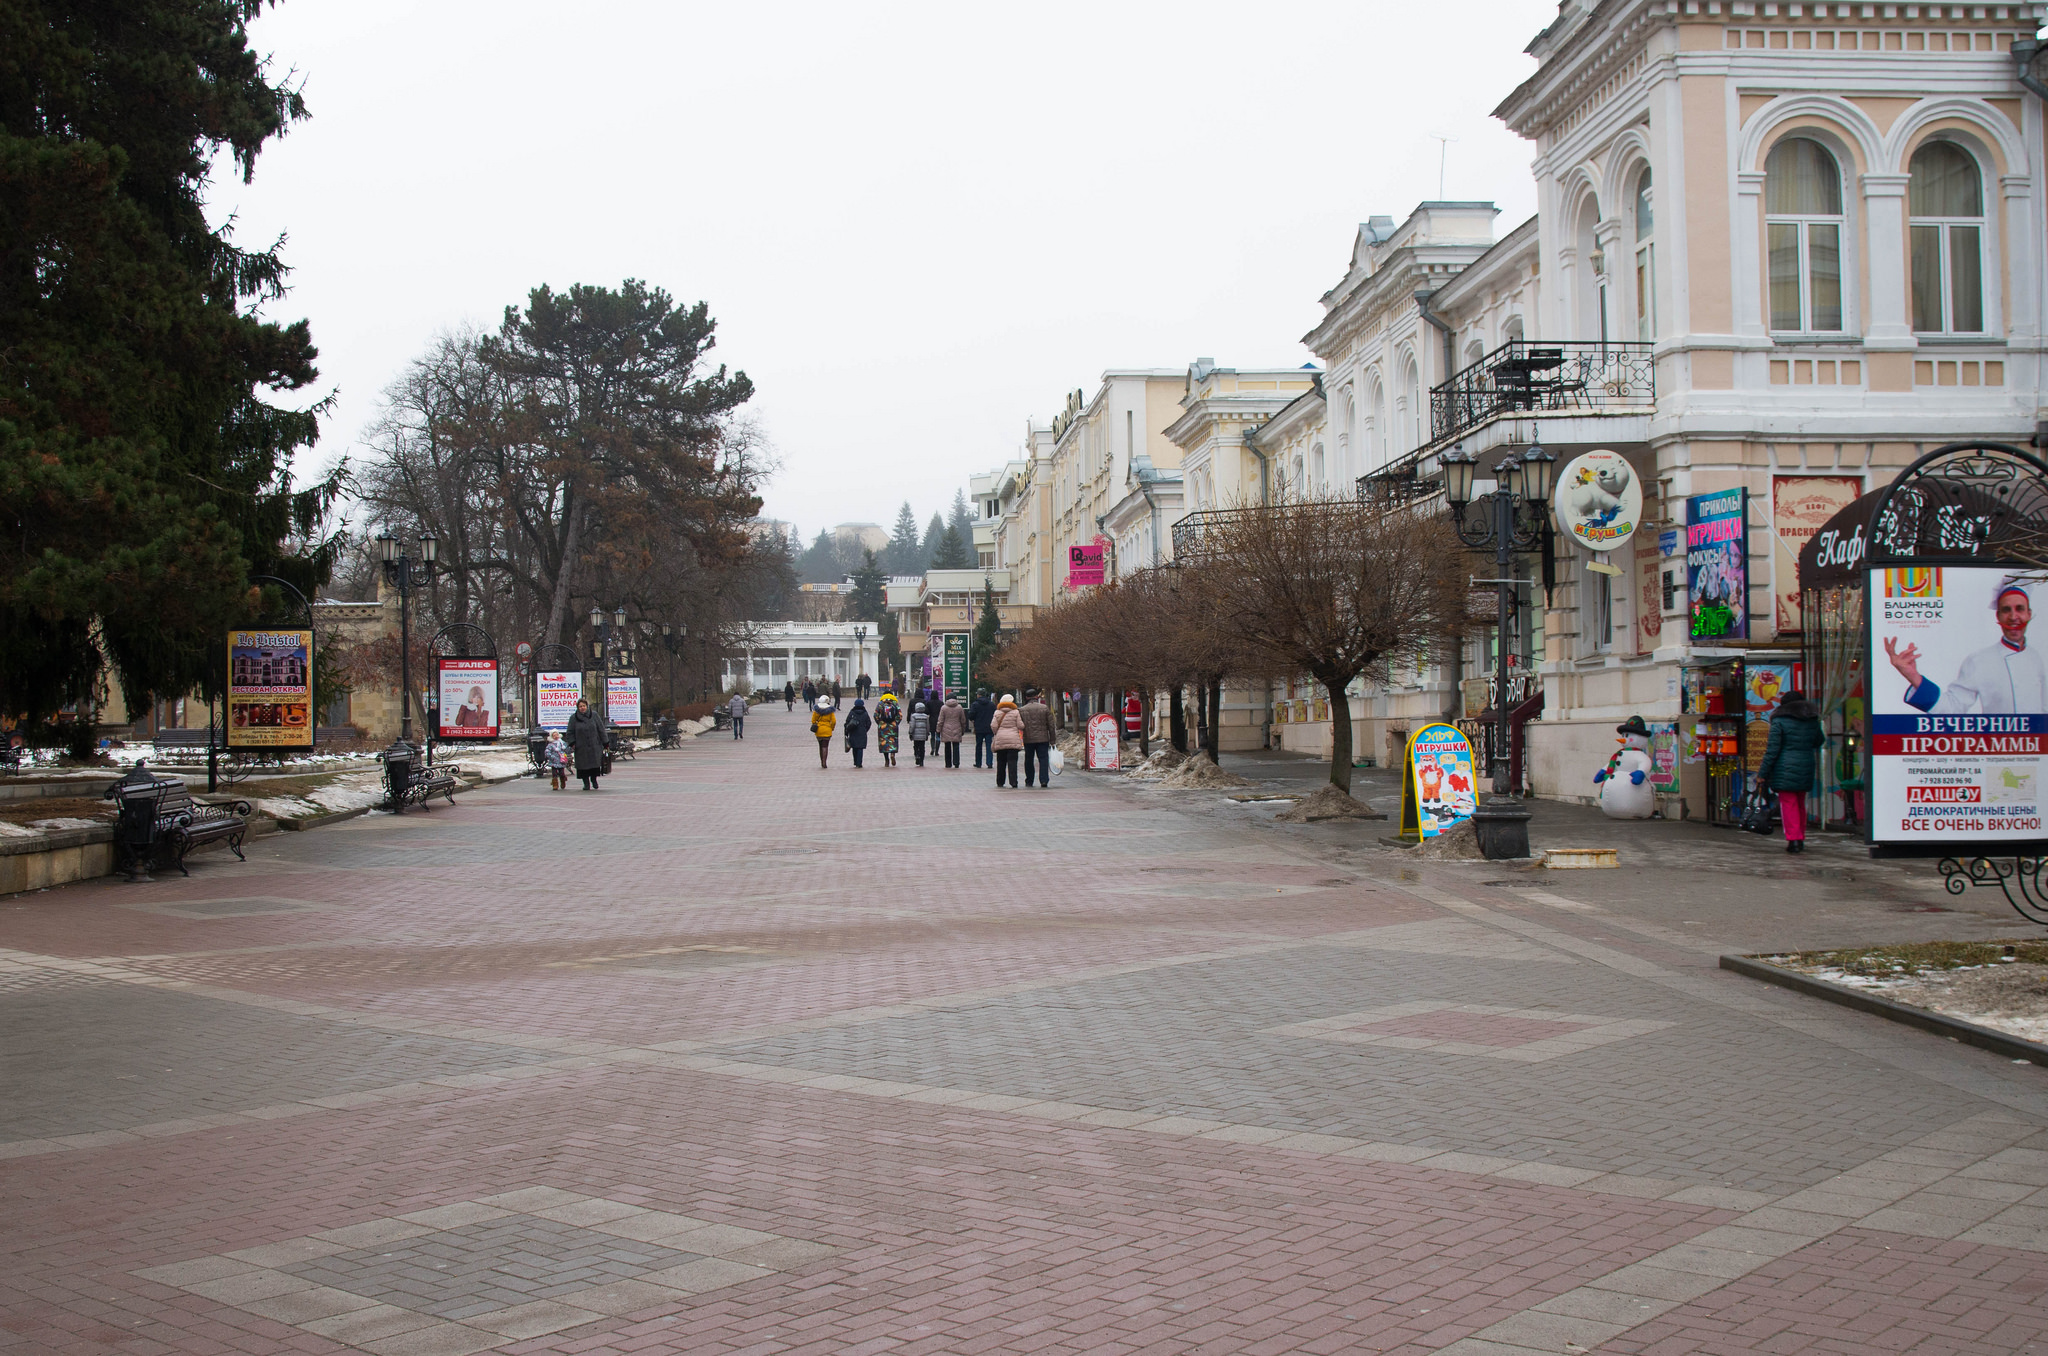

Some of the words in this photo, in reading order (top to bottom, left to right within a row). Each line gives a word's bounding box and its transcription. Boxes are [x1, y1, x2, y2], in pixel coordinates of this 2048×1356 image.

[1700, 494, 1741, 518] ПРИКОЛЫ
[1575, 521, 1633, 542] игрушки
[1688, 517, 1742, 547] ИГРУШКИ
[1071, 548, 1102, 562] David
[1688, 547, 1723, 568] ФОКУСЫ
[1884, 599, 1944, 609] БЛИЖНИЙ
[237, 633, 254, 647] Le
[255, 632, 301, 648] Bristol
[231, 685, 270, 694] РЕСТОРАН
[271, 685, 306, 694] ОТКРЫТ
[540, 692, 579, 700] ШУБНАЯ
[1490, 676, 1526, 704] БЬВАР
[1916, 716, 2031, 733] ВЕЧЕРНИЕ
[1425, 731, 1456, 742] ЭЛЬФ
[1415, 741, 1468, 753] ИГРУШКИ
[1901, 737, 2041, 753] ПРОГРАММЫ
[1908, 767, 1957, 775] ПЕРВОМАЙСКИЙ
[1958, 768, 1973, 776] ПР-Т,
[1908, 806, 2006, 818] ДЕМОКРАТИЧНЫЕ
[2007, 805, 2037, 817] ЦЕНЫ!
[1901, 819, 1930, 831] ВСЕ
[1934, 818, 1985, 831] ОЧЕНЬ
[1988, 818, 2042, 831] ВКУСНО!
